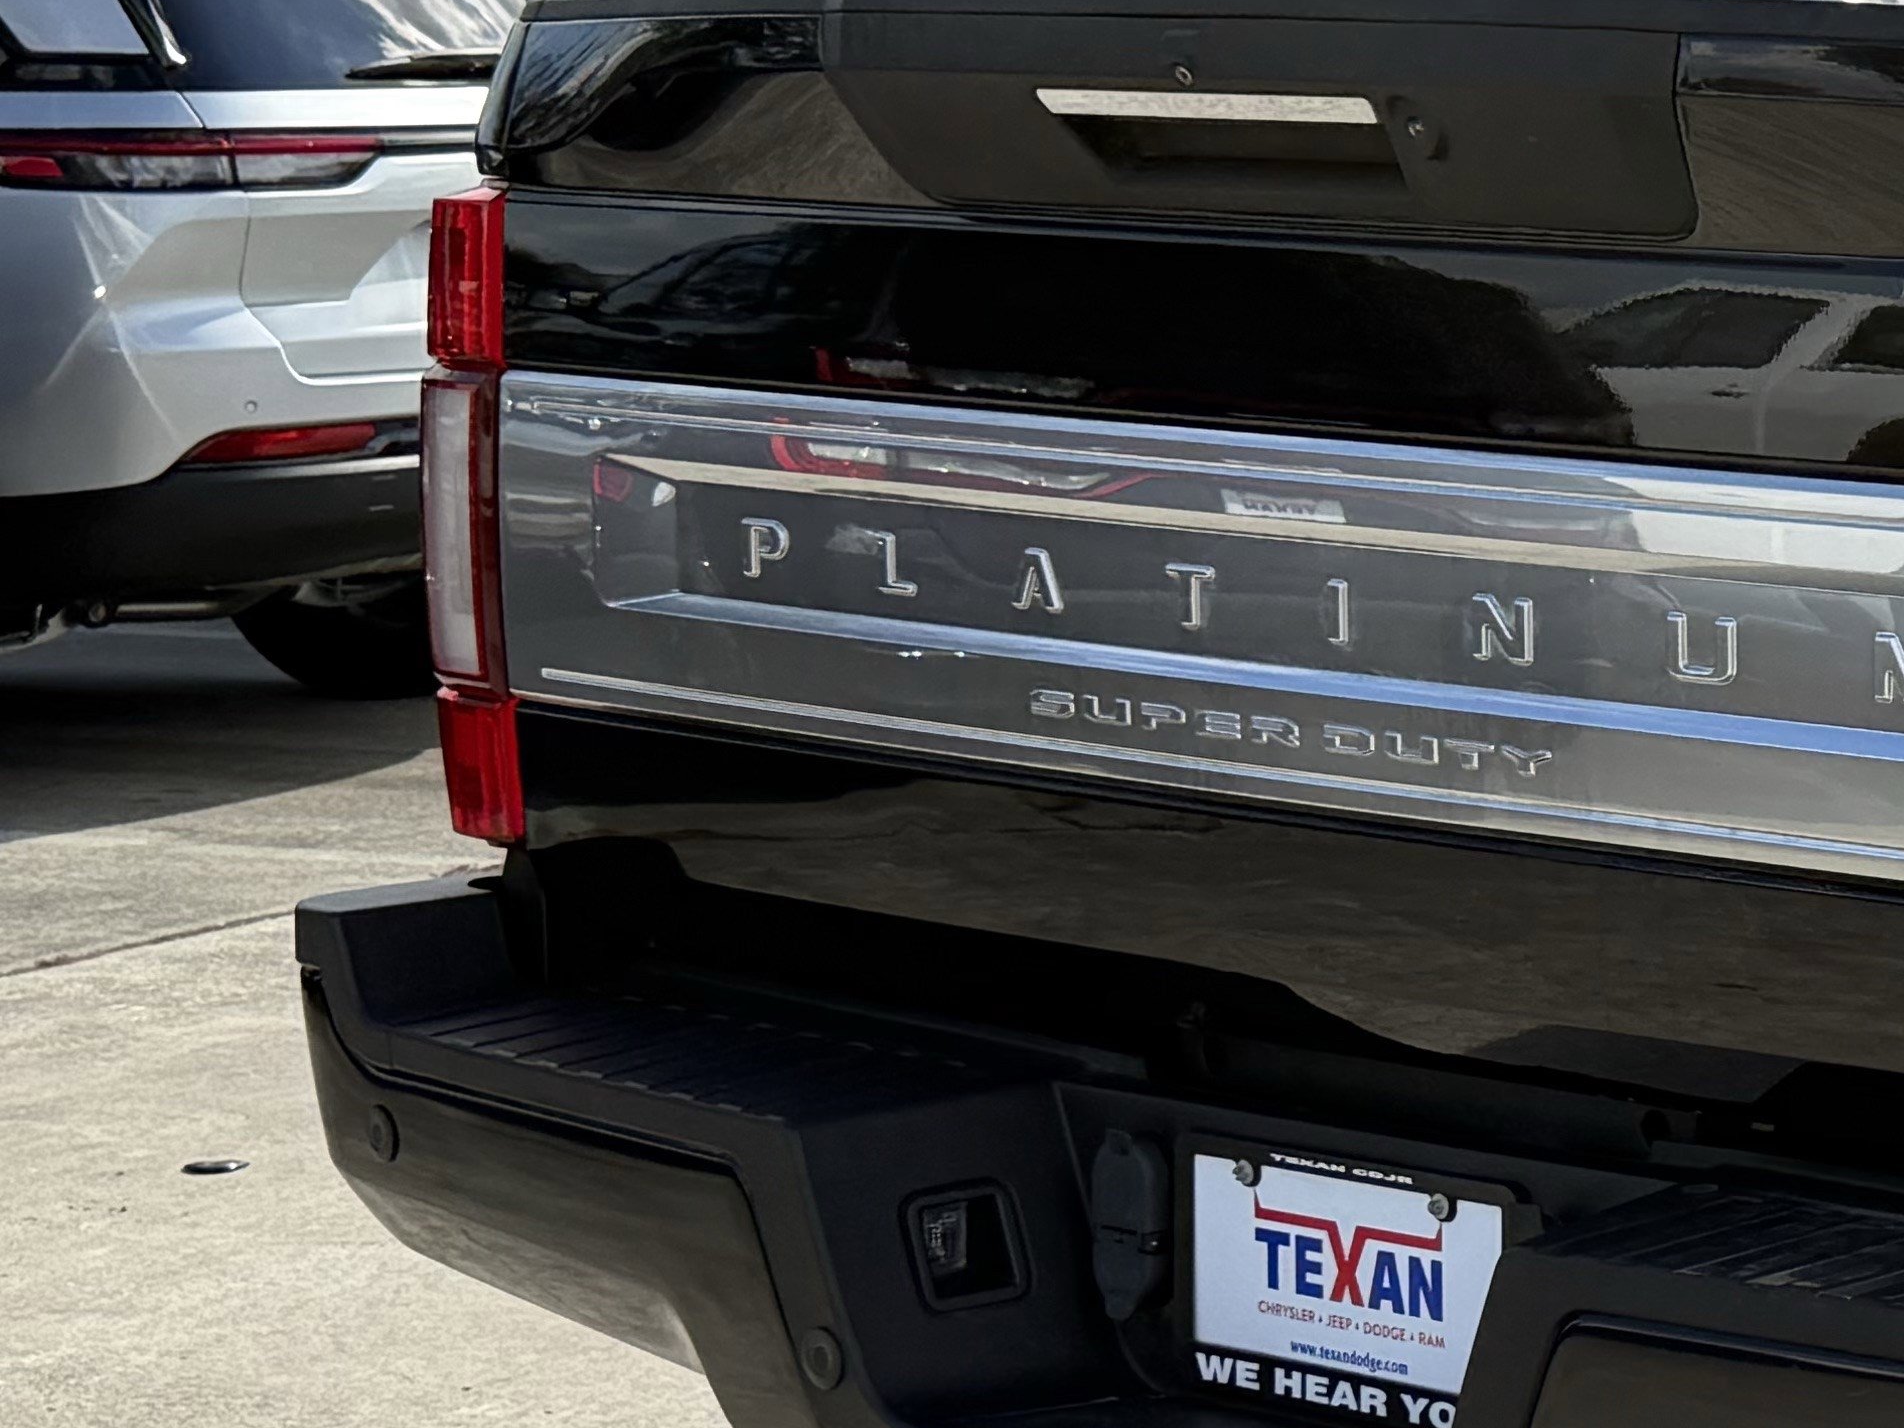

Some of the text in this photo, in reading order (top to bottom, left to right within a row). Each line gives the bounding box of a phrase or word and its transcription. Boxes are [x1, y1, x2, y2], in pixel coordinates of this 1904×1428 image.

[1029, 688, 1553, 778] SUPER DUTY
[1270, 1152, 1346, 1173] TEXAN
[1254, 1189, 1444, 1322] TEXAN
[1257, 1299, 1446, 1349] CHRYSLER JEEP DODGE RAM
[1195, 1351, 1260, 1391] WE
[1274, 1367, 1388, 1418] HEAR
[1290, 1339, 1409, 1376] www.texandodge.com
